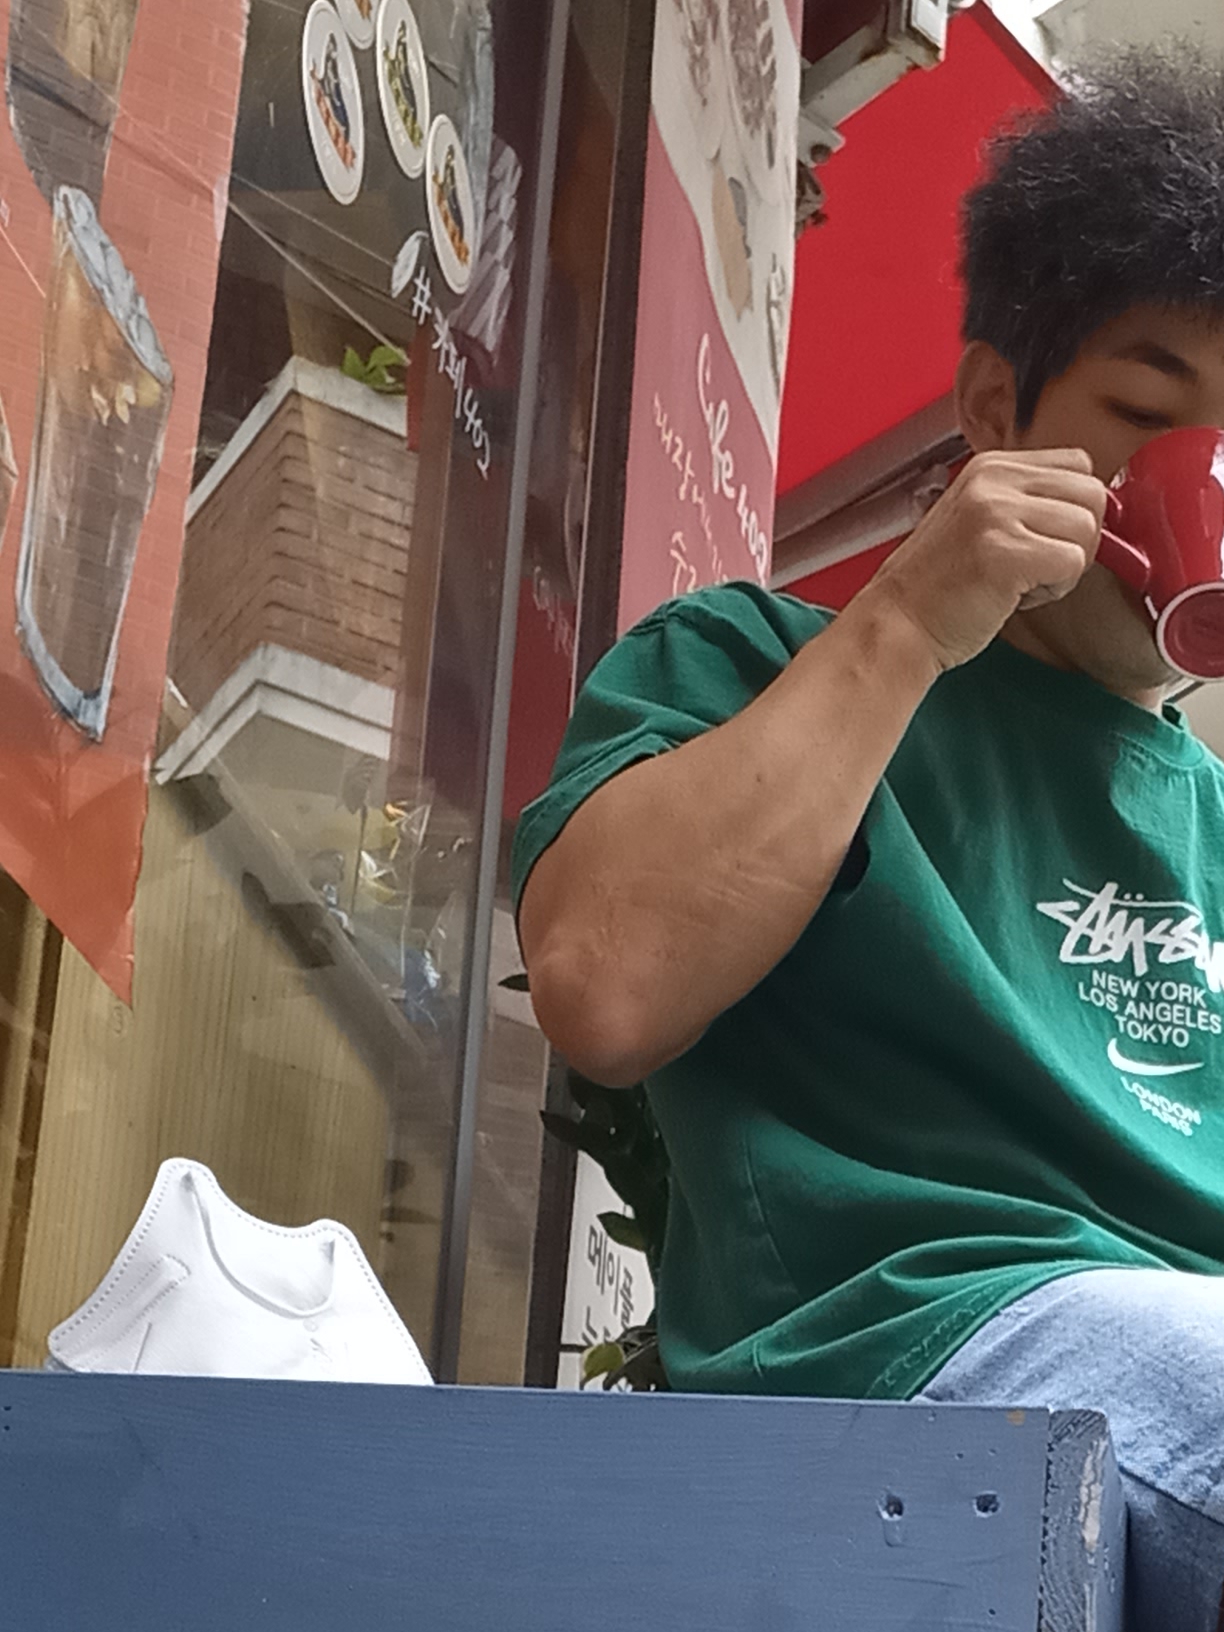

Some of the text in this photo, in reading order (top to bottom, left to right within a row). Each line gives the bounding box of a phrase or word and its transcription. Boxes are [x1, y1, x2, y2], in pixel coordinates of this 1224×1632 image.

[1092, 969, 1207, 1007] NEW YORK
[1078, 982, 1222, 1034] LOS ANGELES
[1114, 1015, 1190, 1048] TOKYO
[1120, 1077, 1202, 1126] LONDON
[1140, 1100, 1193, 1137] PARIS
